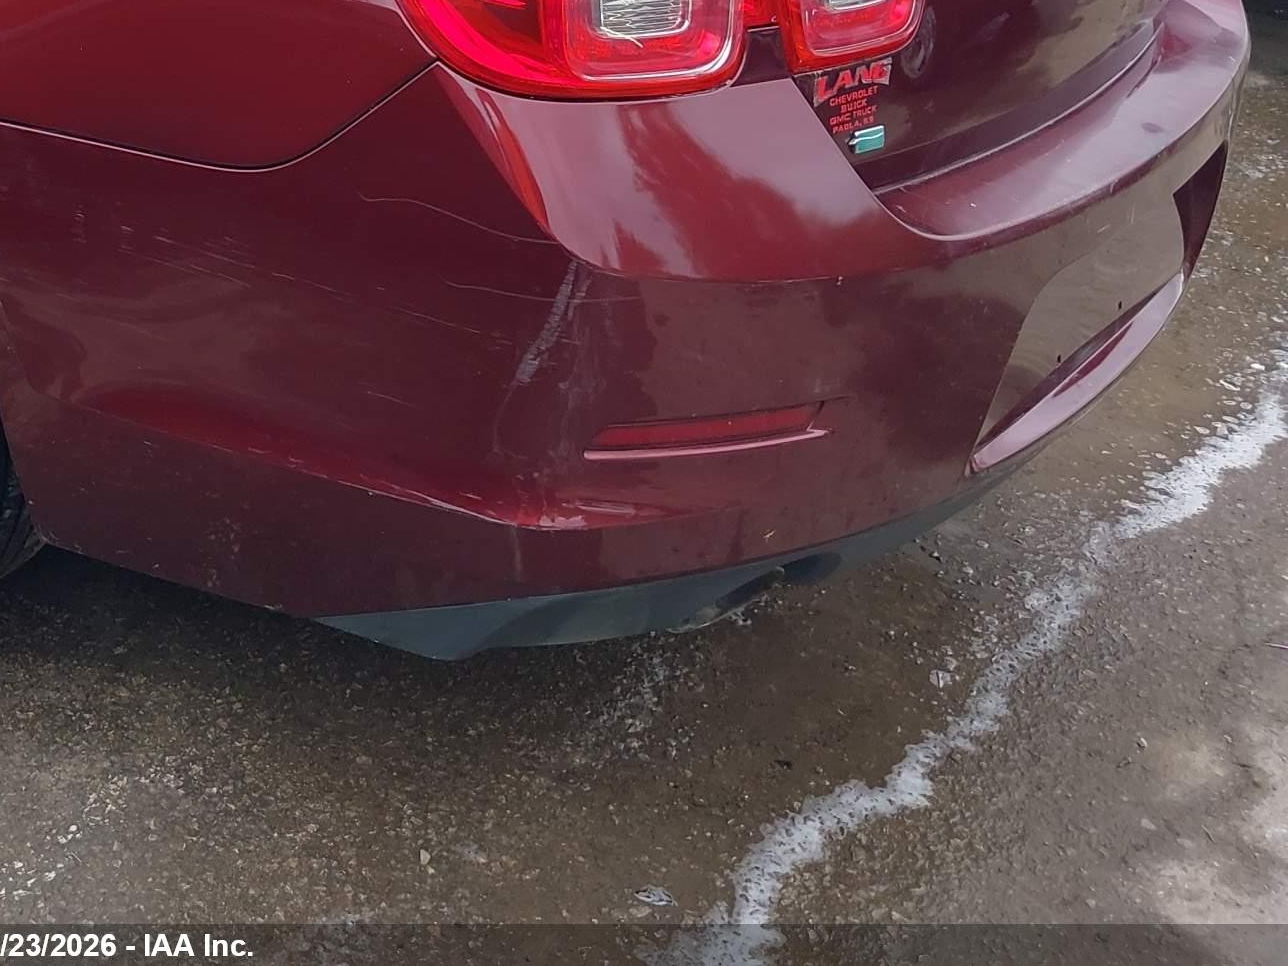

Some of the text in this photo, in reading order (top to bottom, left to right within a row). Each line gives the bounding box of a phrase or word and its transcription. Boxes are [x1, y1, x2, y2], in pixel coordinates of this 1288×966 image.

[829, 85, 879, 107] CHEVROLET
[840, 98, 868, 113] BUICK
[829, 105, 878, 126] GMC TRUCK
